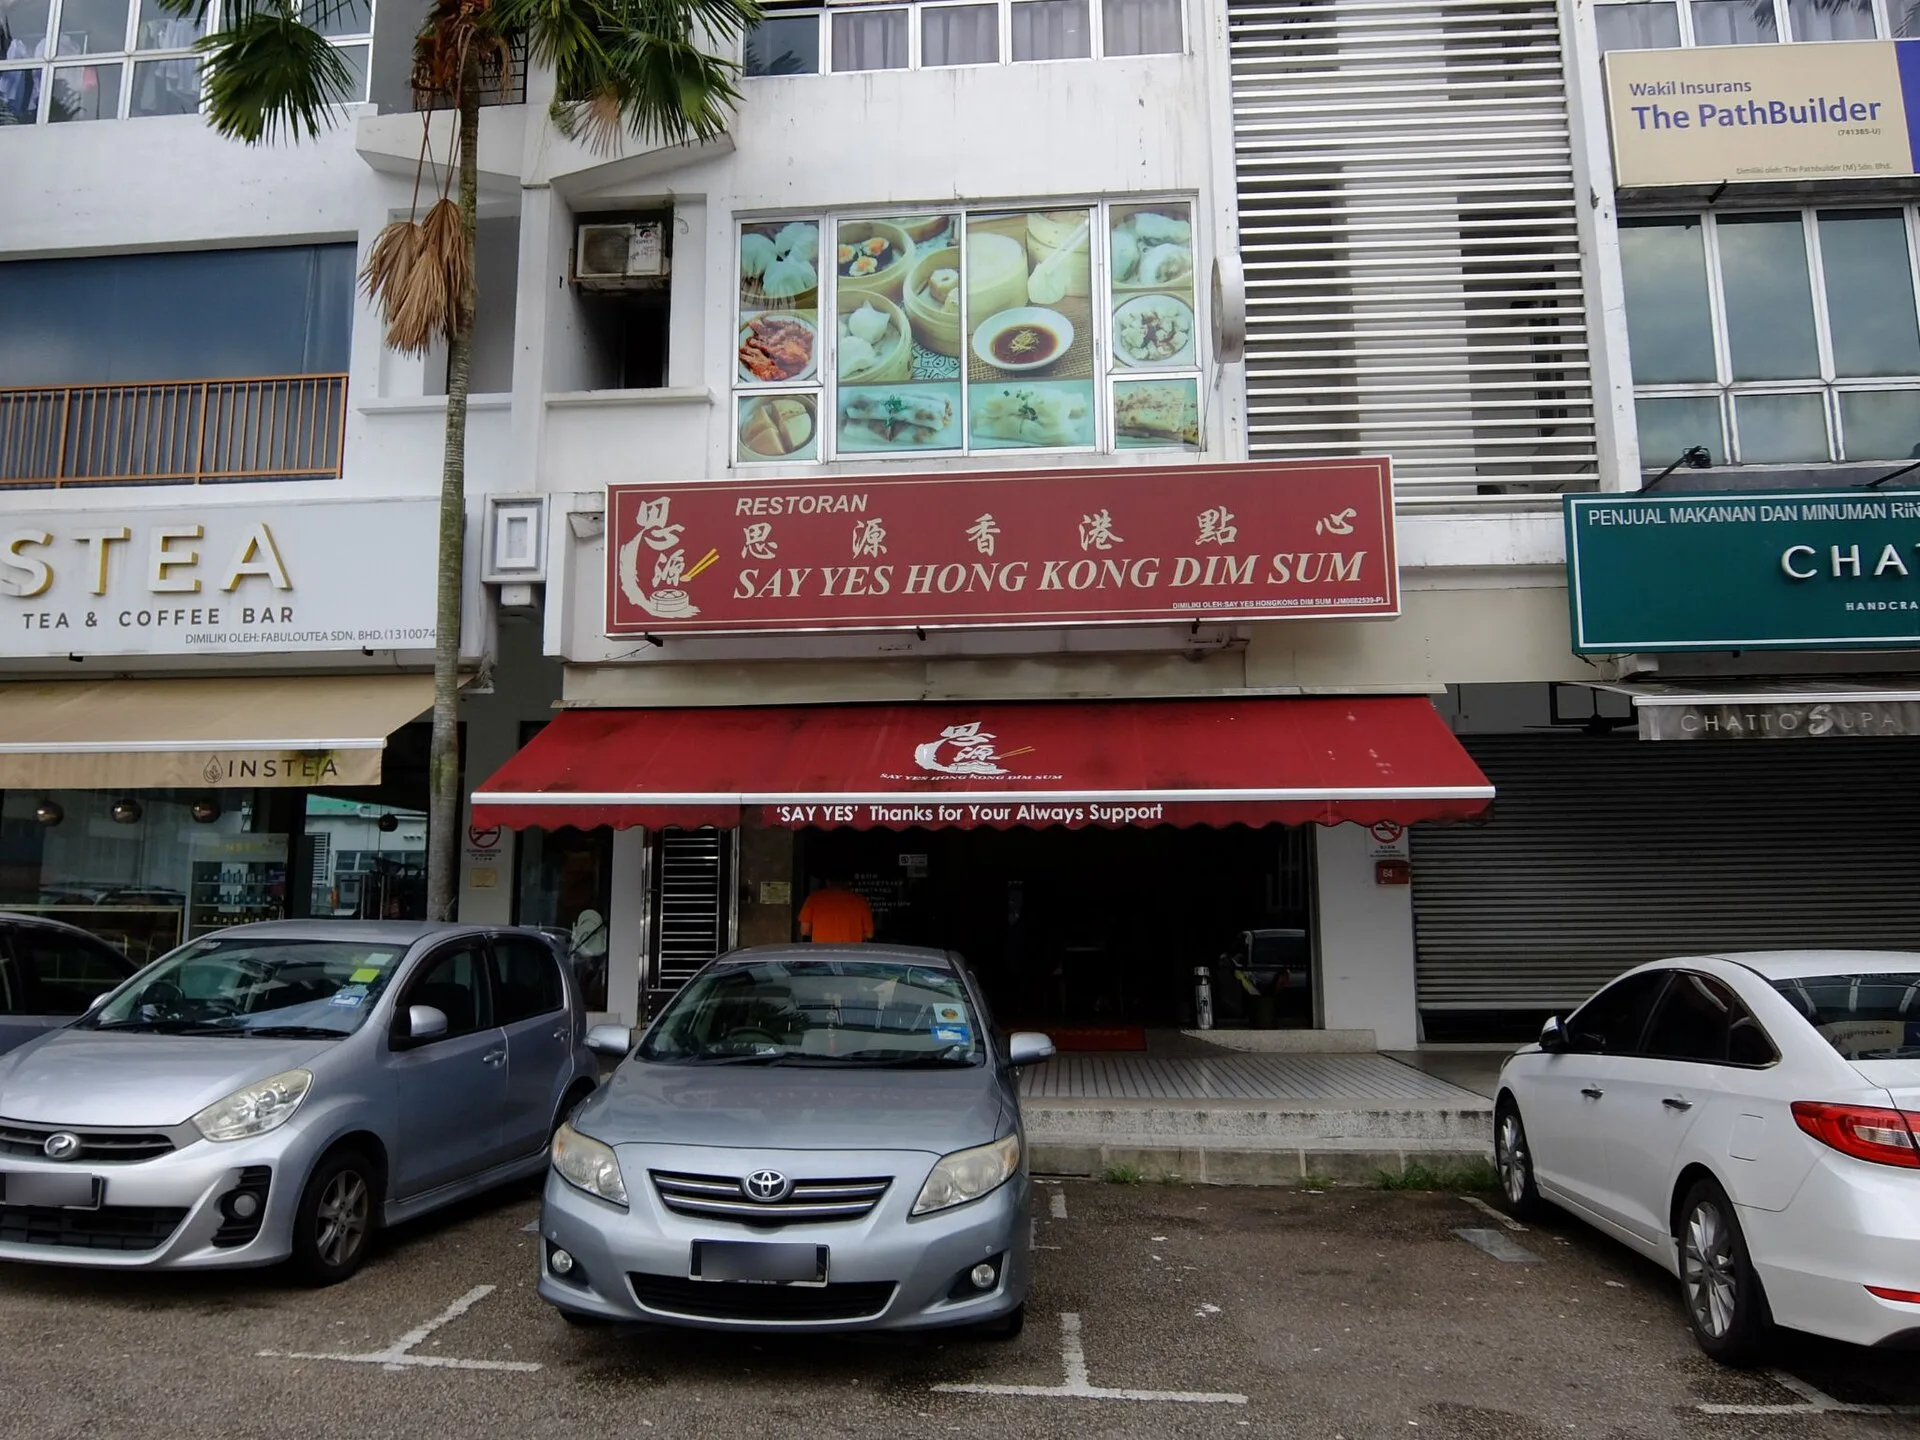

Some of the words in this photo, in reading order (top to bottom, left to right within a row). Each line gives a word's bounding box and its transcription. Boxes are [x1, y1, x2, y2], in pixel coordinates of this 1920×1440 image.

[1629, 81, 1676, 97] Wakil
[1680, 80, 1752, 95] Insurans
[1631, 105, 1690, 130] The
[1698, 96, 1881, 128] PathBuilder
[1785, 165, 1797, 173] The
[735, 494, 868, 517] RESTORAN
[1589, 509, 1666, 526] PENJUAL
[1669, 506, 1756, 524] MAKANAN
[1760, 505, 1797, 522] DAN
[1802, 503, 1887, 521] MINUMAN
[1781, 543, 1920, 578] CHA
[733, 567, 812, 600] SAY
[819, 565, 894, 597] YES
[902, 560, 1028, 594] HONG
[1036, 557, 1160, 592] KONG
[1168, 554, 1260, 587] DIM
[1267, 551, 1368, 585] SUM
[1239, 600, 1254, 608] YES
[1255, 598, 1298, 607] HONGKONG
[1300, 598, 1313, 606] DIM
[1315, 597, 1331, 605] SUM
[22, 612, 70, 629] TEA
[85, 611, 98, 627] &
[119, 608, 220, 627] COFFEE
[242, 606, 294, 624] BAR
[185, 633, 227, 644] DIMILIKI
[261, 631, 329, 643] FABULOUTEA
[228, 759, 338, 779] INSTEA
[880, 772, 903, 780] SAY
[970, 773, 1005, 781] KONG
[869, 804, 933, 822] Thanks
[938, 804, 963, 821] for
[968, 804, 1011, 821] Your
[1016, 803, 1084, 824] Always
[1089, 803, 1163, 823] Support
